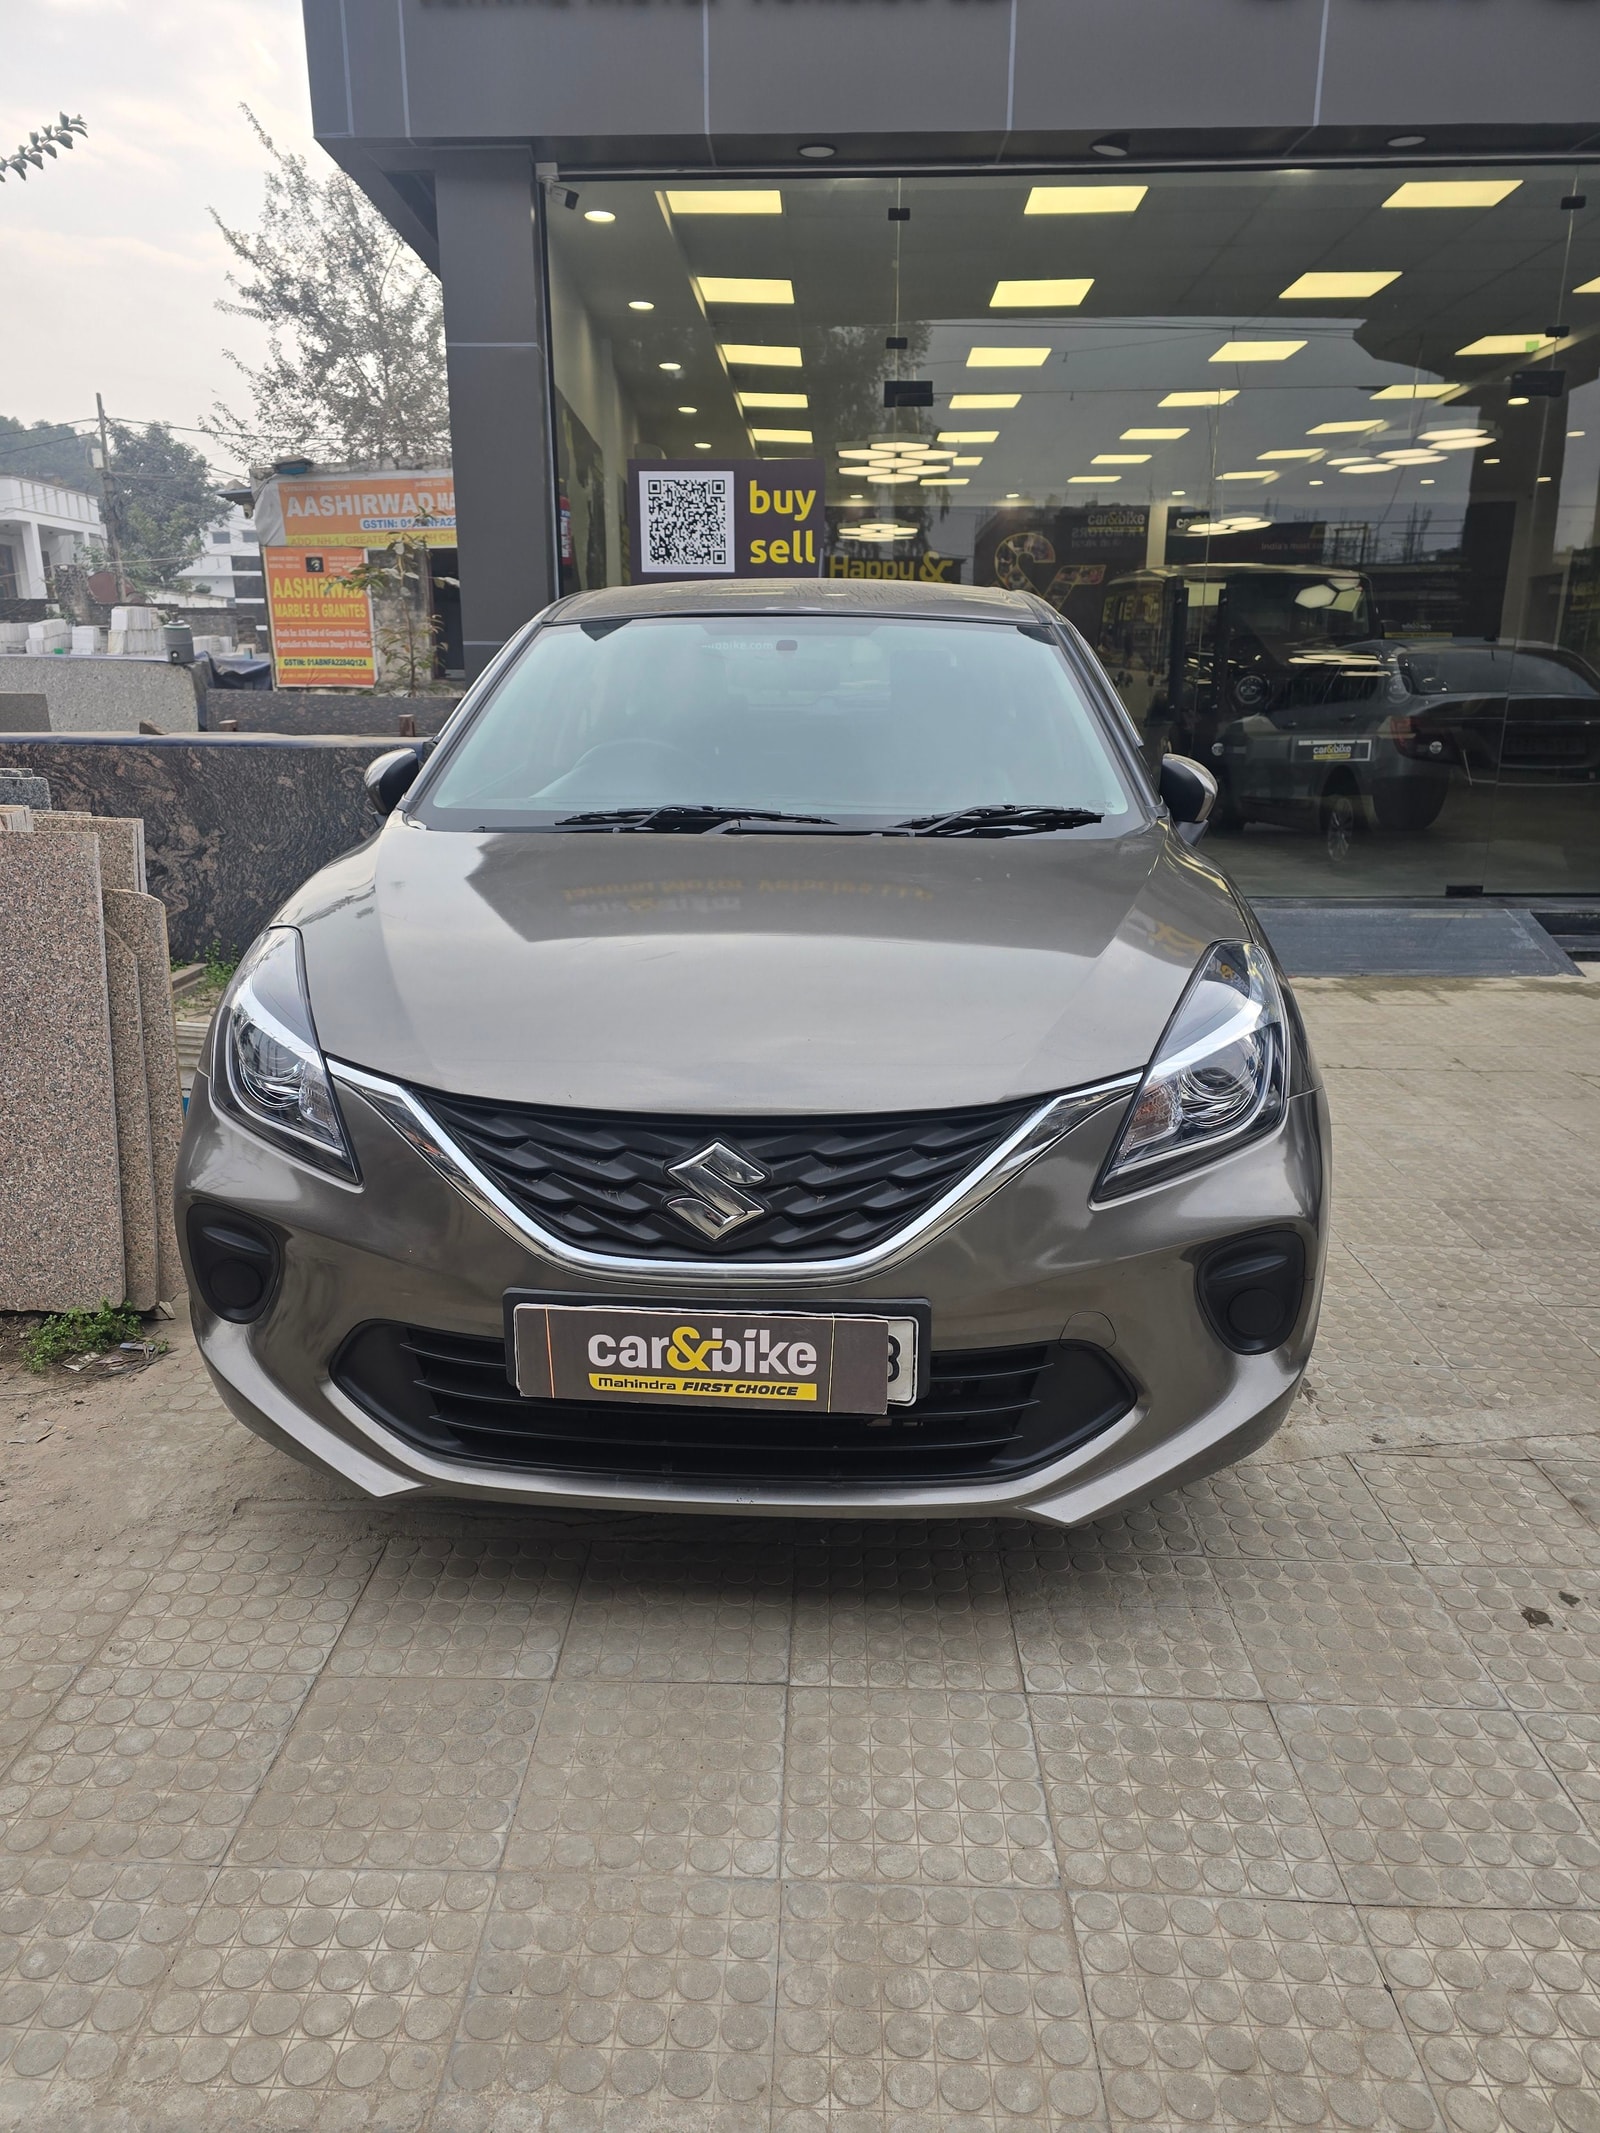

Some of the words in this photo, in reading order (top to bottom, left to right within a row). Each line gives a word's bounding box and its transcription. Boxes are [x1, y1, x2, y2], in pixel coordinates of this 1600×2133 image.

[286, 493, 434, 517] AASHIRWAD
[750, 480, 816, 521] buy
[362, 518, 398, 530] GSTIN:
[1088, 511, 1145, 525] car&bike
[750, 530, 816, 564] sell
[829, 555, 914, 581] Happy
[274, 603, 310, 618] MARBLE
[313, 603, 320, 618] &
[322, 603, 366, 618] GRANITES
[587, 1326, 818, 1376] car&bike
[598, 1377, 676, 1391] Mahindra
[682, 1382, 734, 1394] FIRST
[735, 1383, 799, 1397] CHOICE
